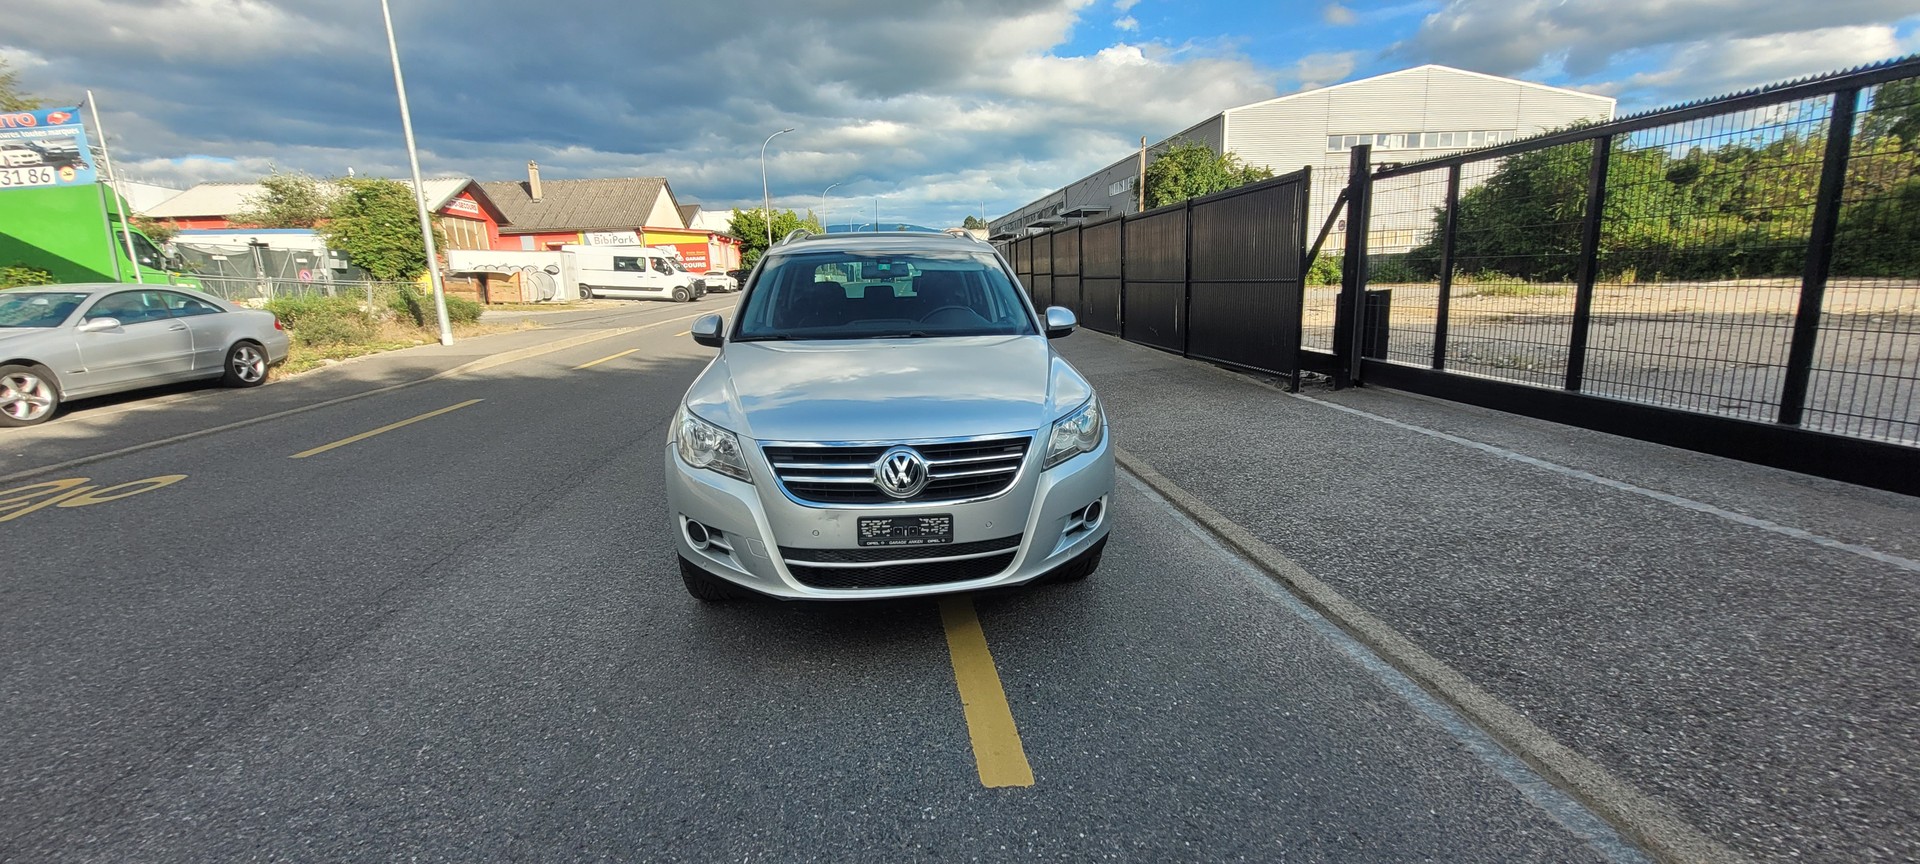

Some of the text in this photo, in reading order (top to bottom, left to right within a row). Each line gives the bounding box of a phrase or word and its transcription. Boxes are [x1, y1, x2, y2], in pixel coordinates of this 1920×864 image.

[0, 168, 51, 185] 31 86
[593, 234, 635, 245] BibiPark
